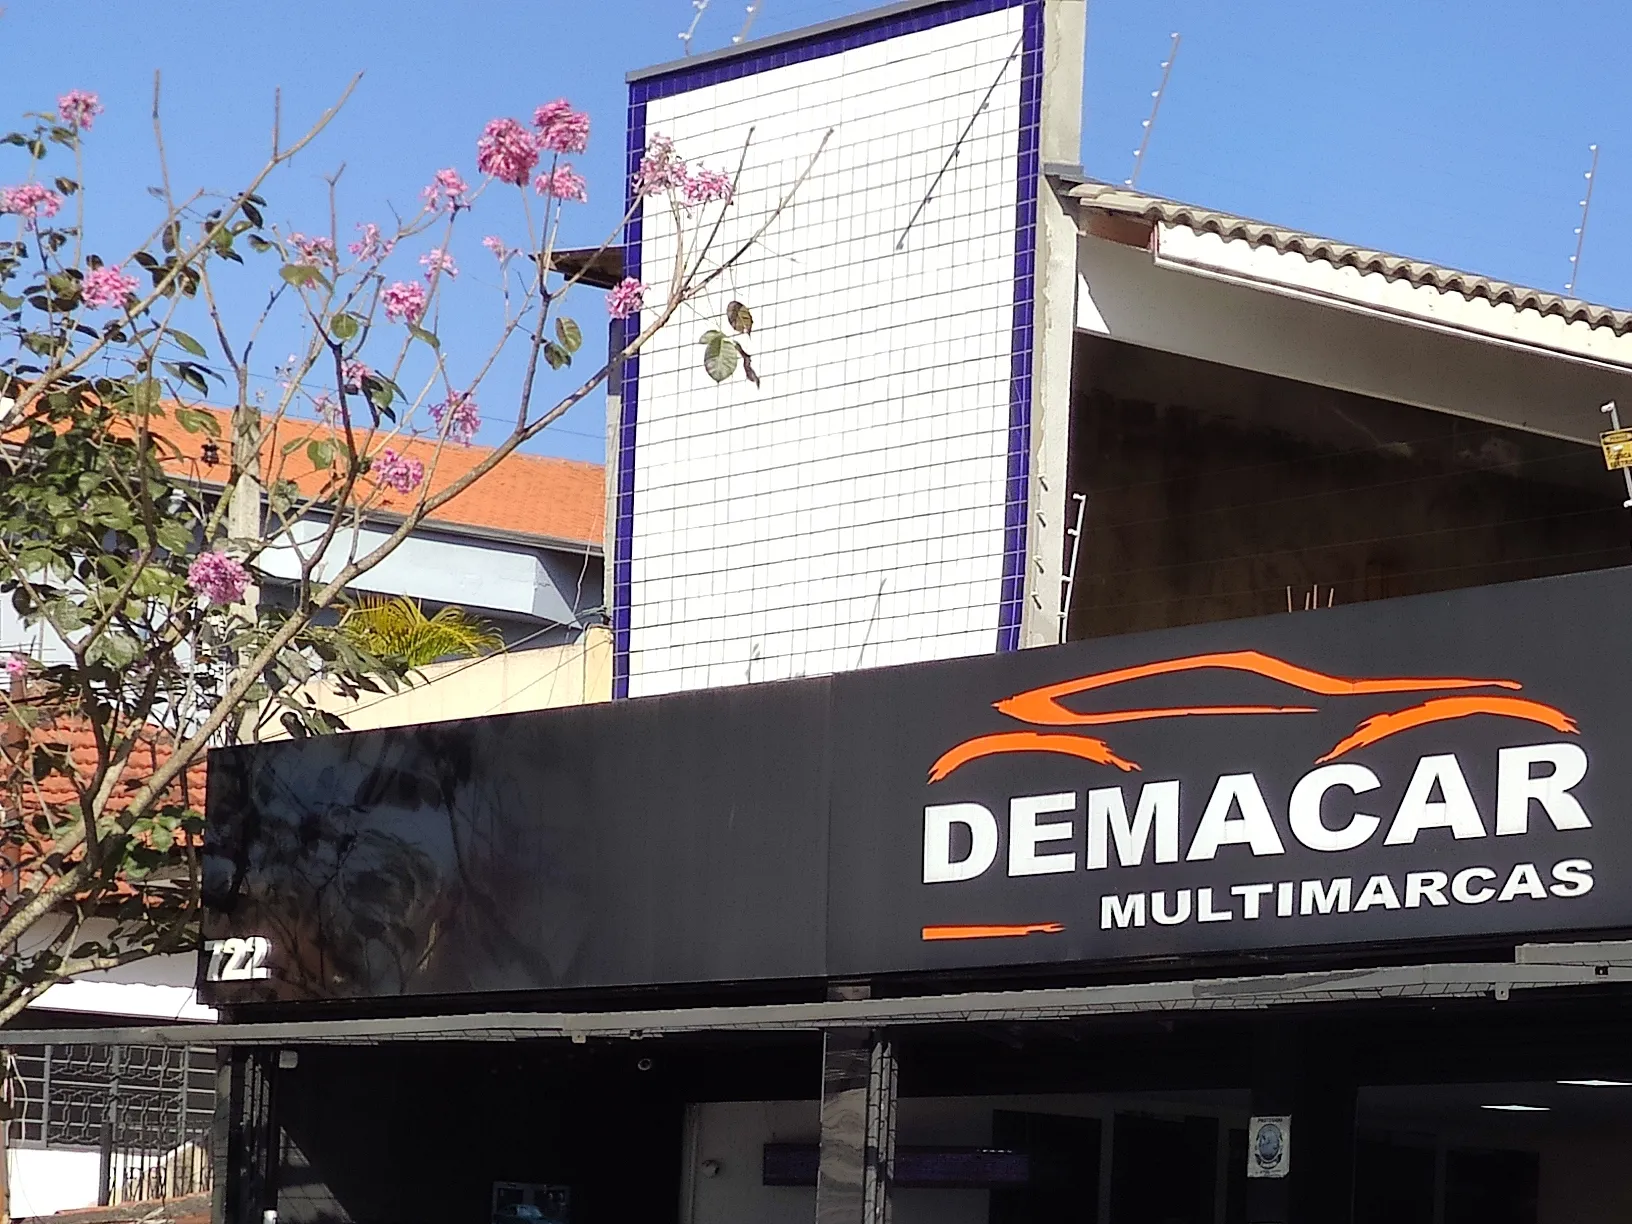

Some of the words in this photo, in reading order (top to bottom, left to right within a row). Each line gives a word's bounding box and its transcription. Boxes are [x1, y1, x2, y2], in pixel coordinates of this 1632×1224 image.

[923, 743, 1593, 884] DEMACAR
[1100, 858, 1594, 930] MULTIMARCAS
[204, 937, 272, 981] 722
